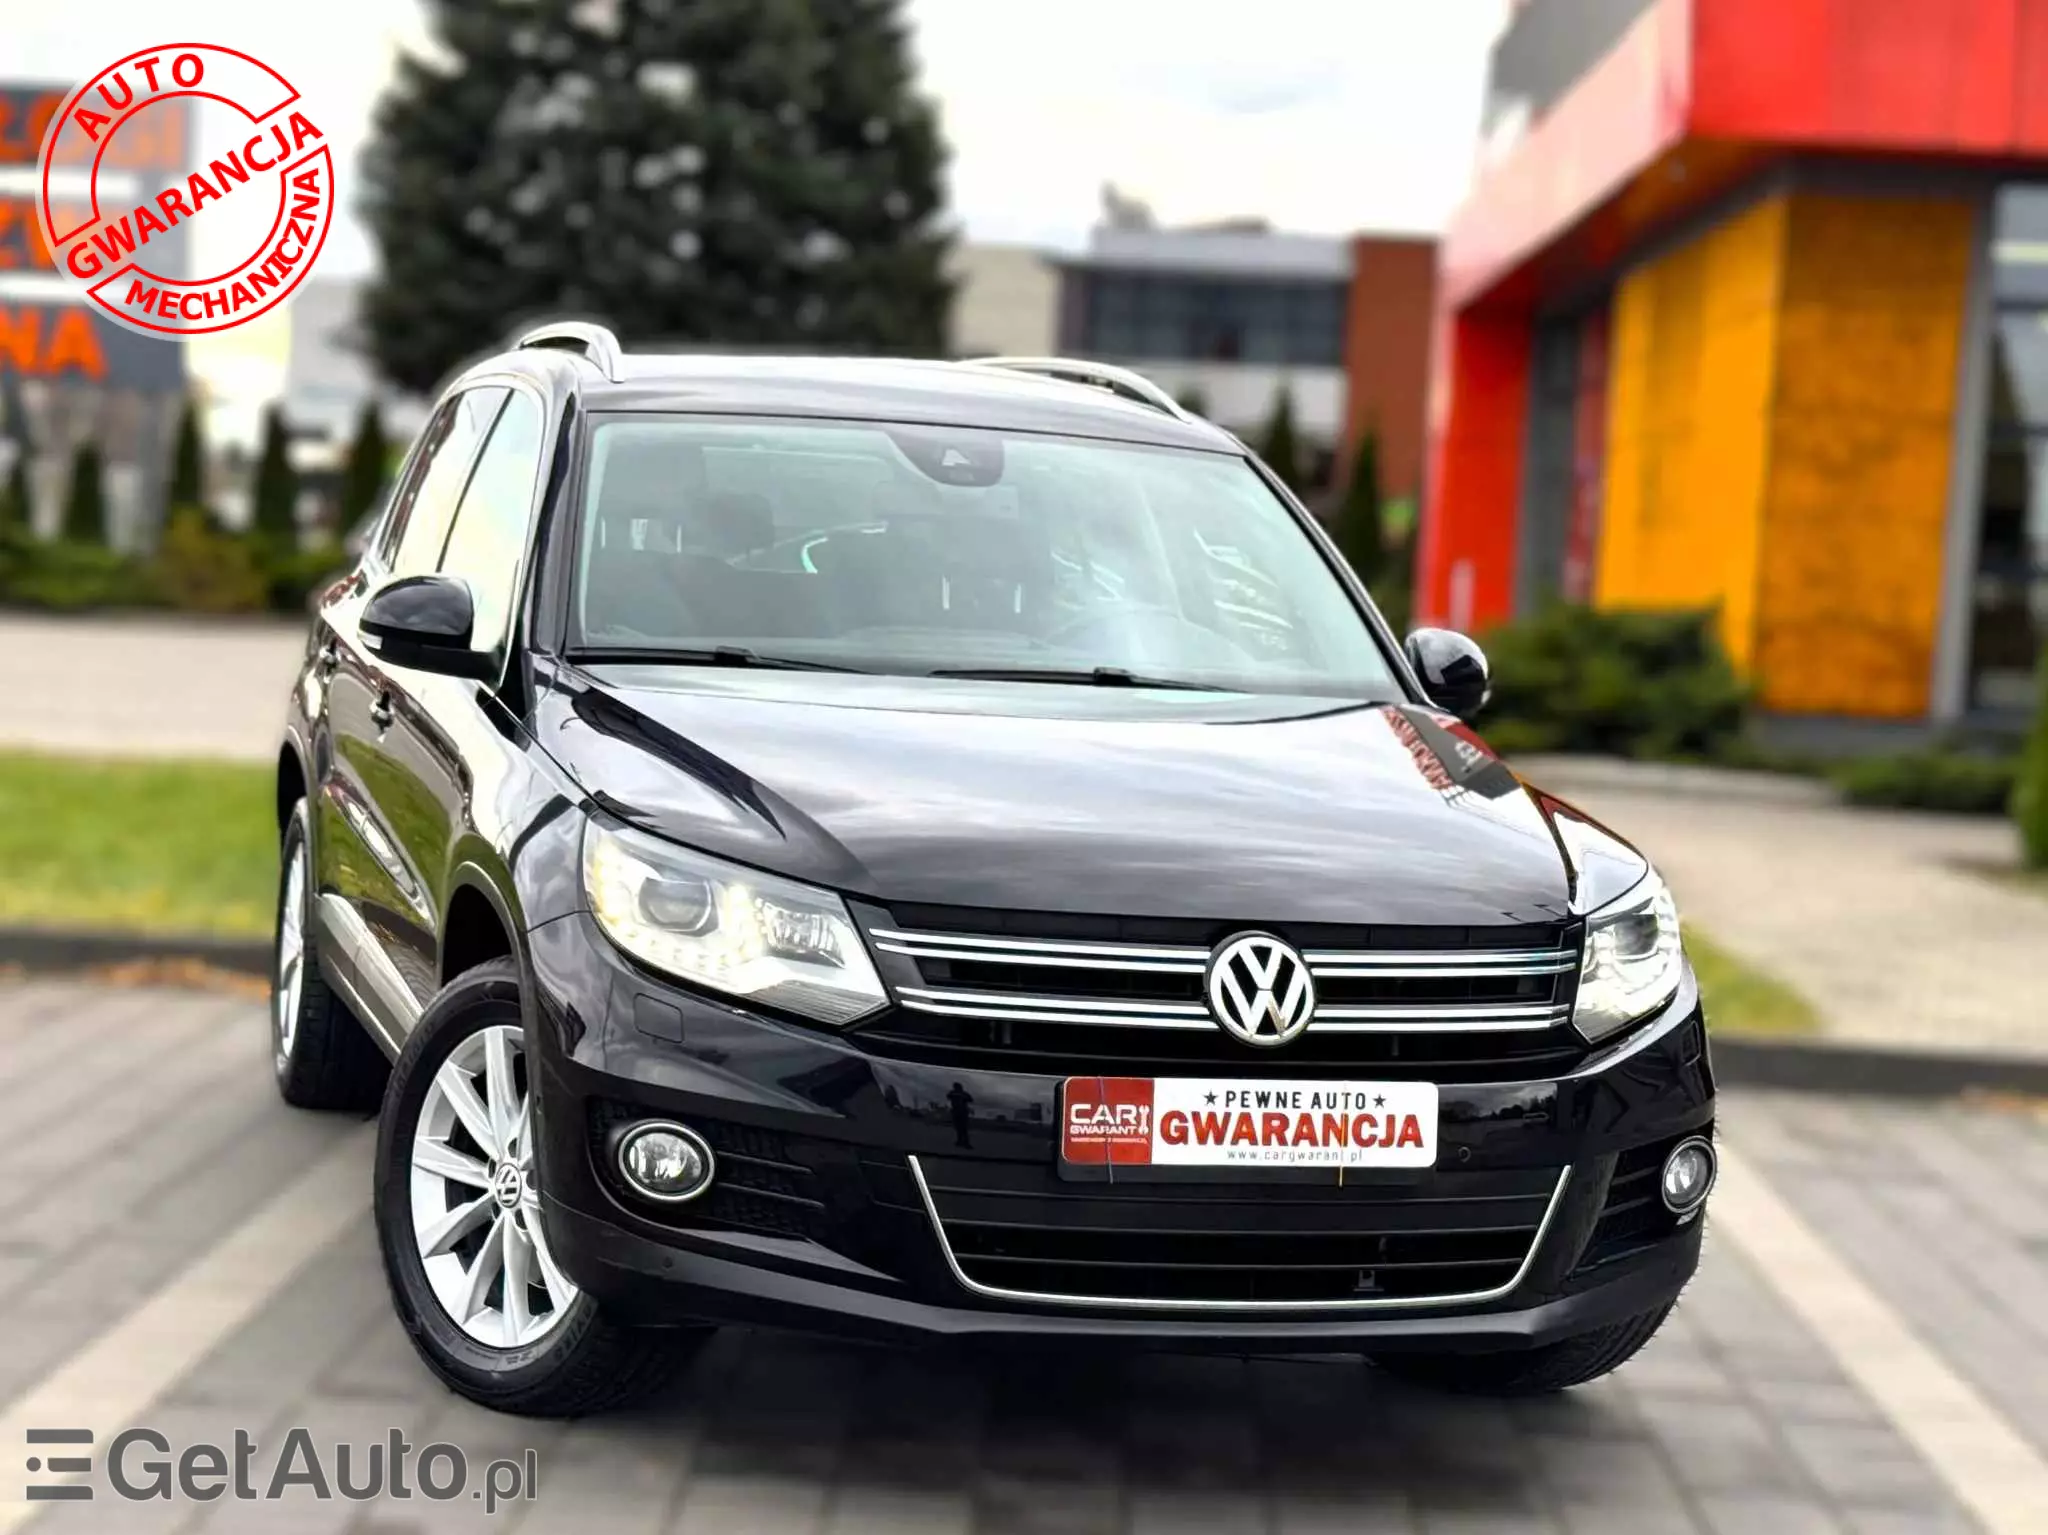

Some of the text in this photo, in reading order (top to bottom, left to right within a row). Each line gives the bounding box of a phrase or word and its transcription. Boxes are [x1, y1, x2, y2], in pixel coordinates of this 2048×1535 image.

[1225, 1091, 1366, 1110] PEWNE AUTO
[1070, 1103, 1137, 1125] CAR
[1159, 1110, 1425, 1148] GWARANCJA
